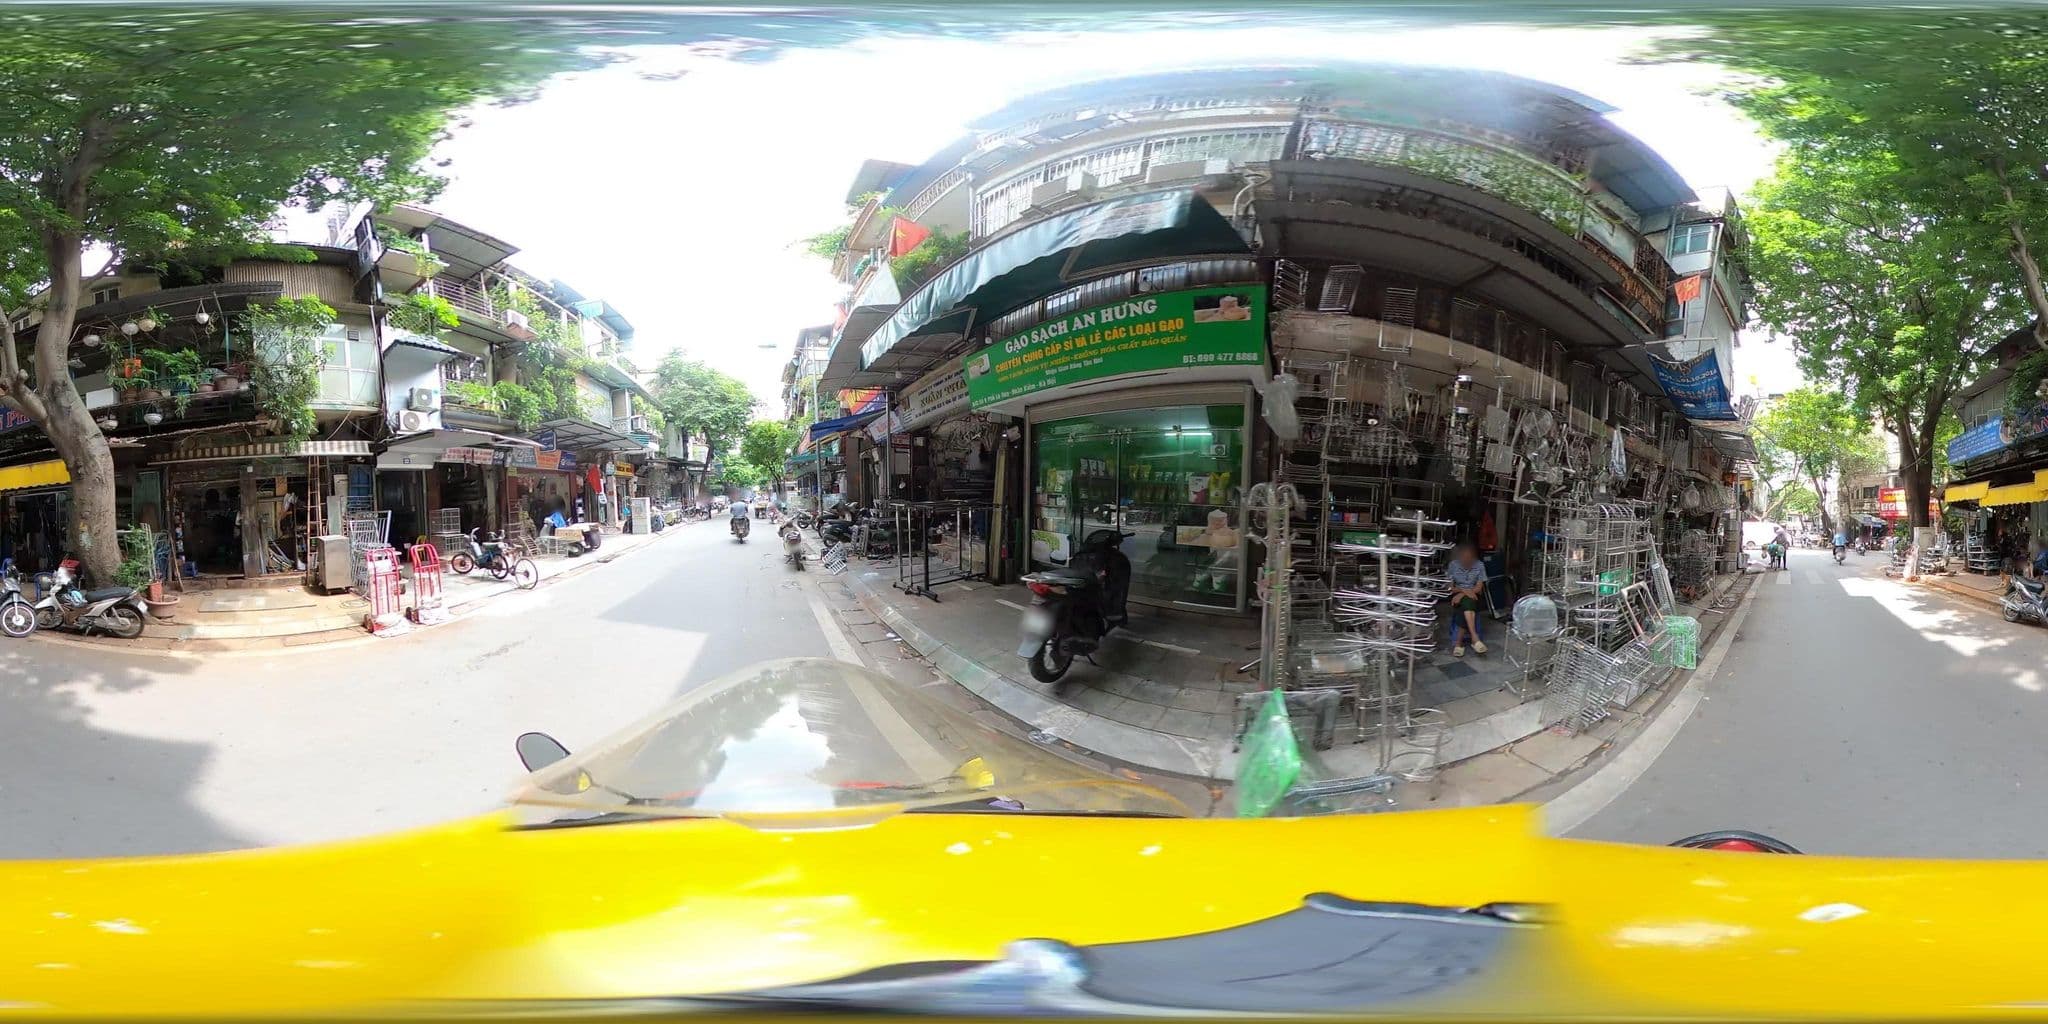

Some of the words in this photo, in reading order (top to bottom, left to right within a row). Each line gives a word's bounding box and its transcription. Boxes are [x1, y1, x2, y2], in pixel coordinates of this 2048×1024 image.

[1005, 335, 1029, 354] GẠO
[1031, 319, 1069, 344] SẠCH
[1072, 311, 1096, 331] AN
[1100, 299, 1158, 324] HƯNG
[1022, 348, 1044, 363] CUNG
[1104, 326, 1127, 341] CÁC
[1129, 321, 1156, 337] LOẠI
[1159, 317, 1185, 333] GẠO
